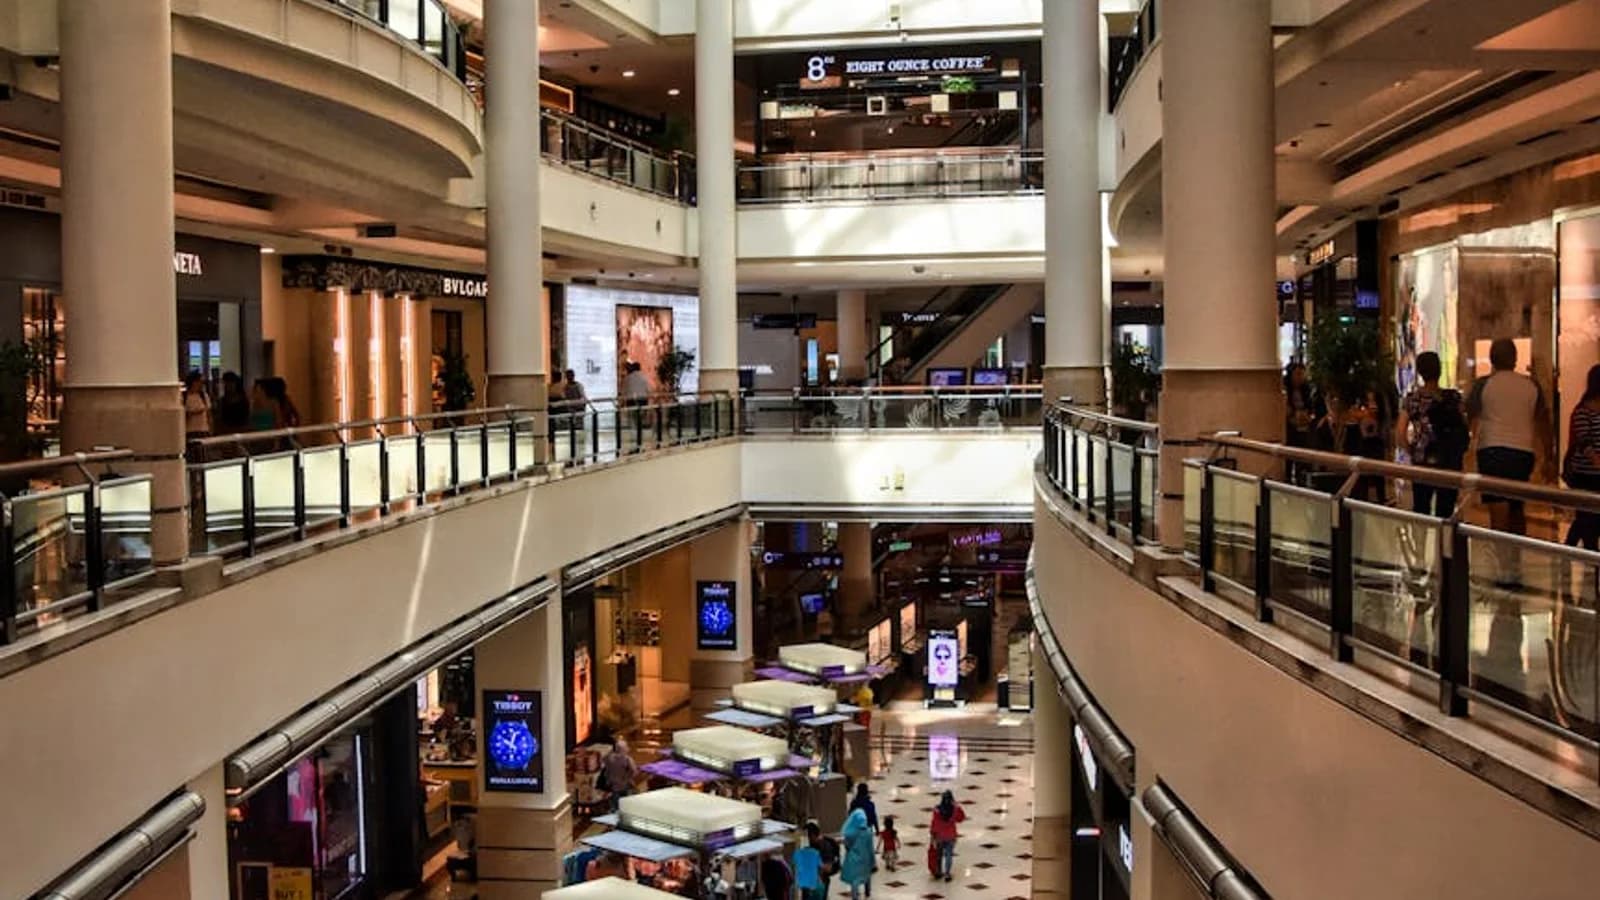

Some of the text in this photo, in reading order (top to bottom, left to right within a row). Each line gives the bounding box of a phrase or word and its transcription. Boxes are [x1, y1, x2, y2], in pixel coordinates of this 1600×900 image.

[808, 56, 826, 81] 8
[846, 61, 885, 73] EIGHT
[888, 60, 930, 72] OUNCE
[932, 57, 984, 71] COFFEE
[493, 701, 533, 711] TISSOT
